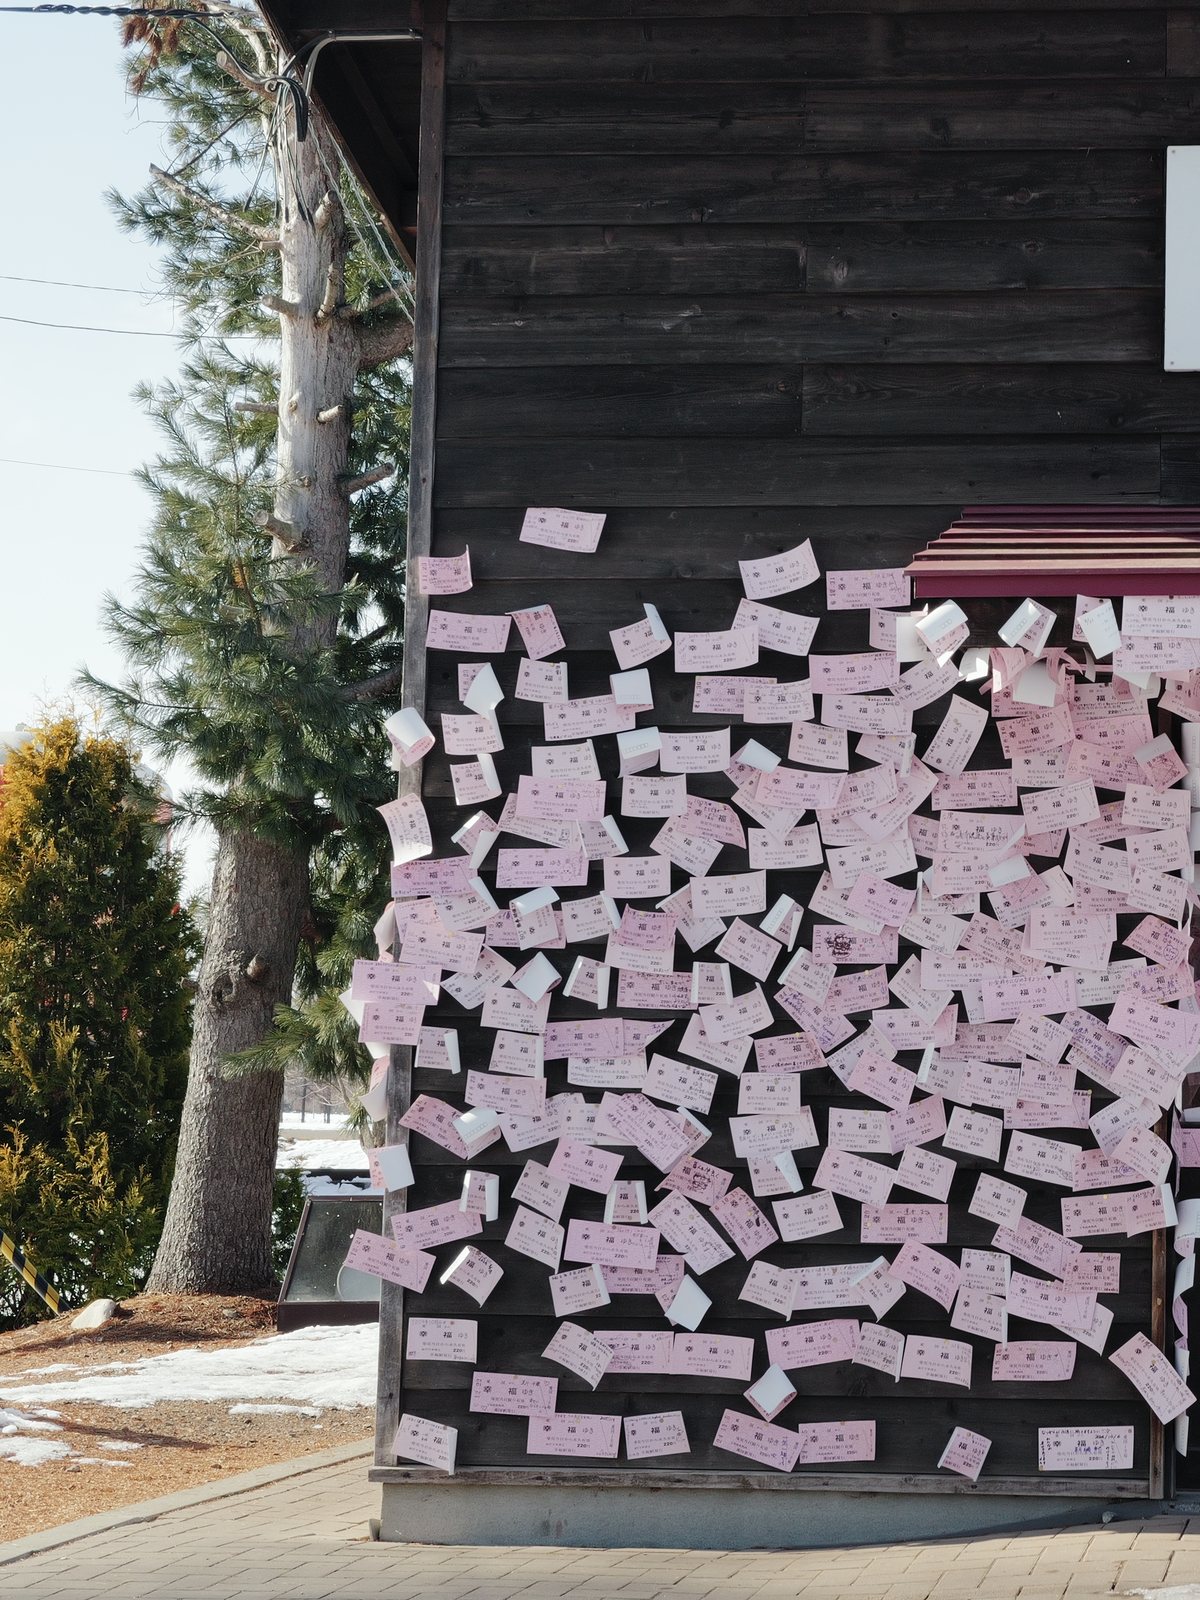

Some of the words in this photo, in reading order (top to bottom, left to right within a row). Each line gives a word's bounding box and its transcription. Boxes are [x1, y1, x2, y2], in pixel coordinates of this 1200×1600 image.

[1154, 642, 1162, 650] 福
[1150, 1015, 1159, 1023] 福
[897, 1216, 905, 1224] 福
[836, 1434, 844, 1442] 福
[1076, 1440, 1087, 1448] 福
